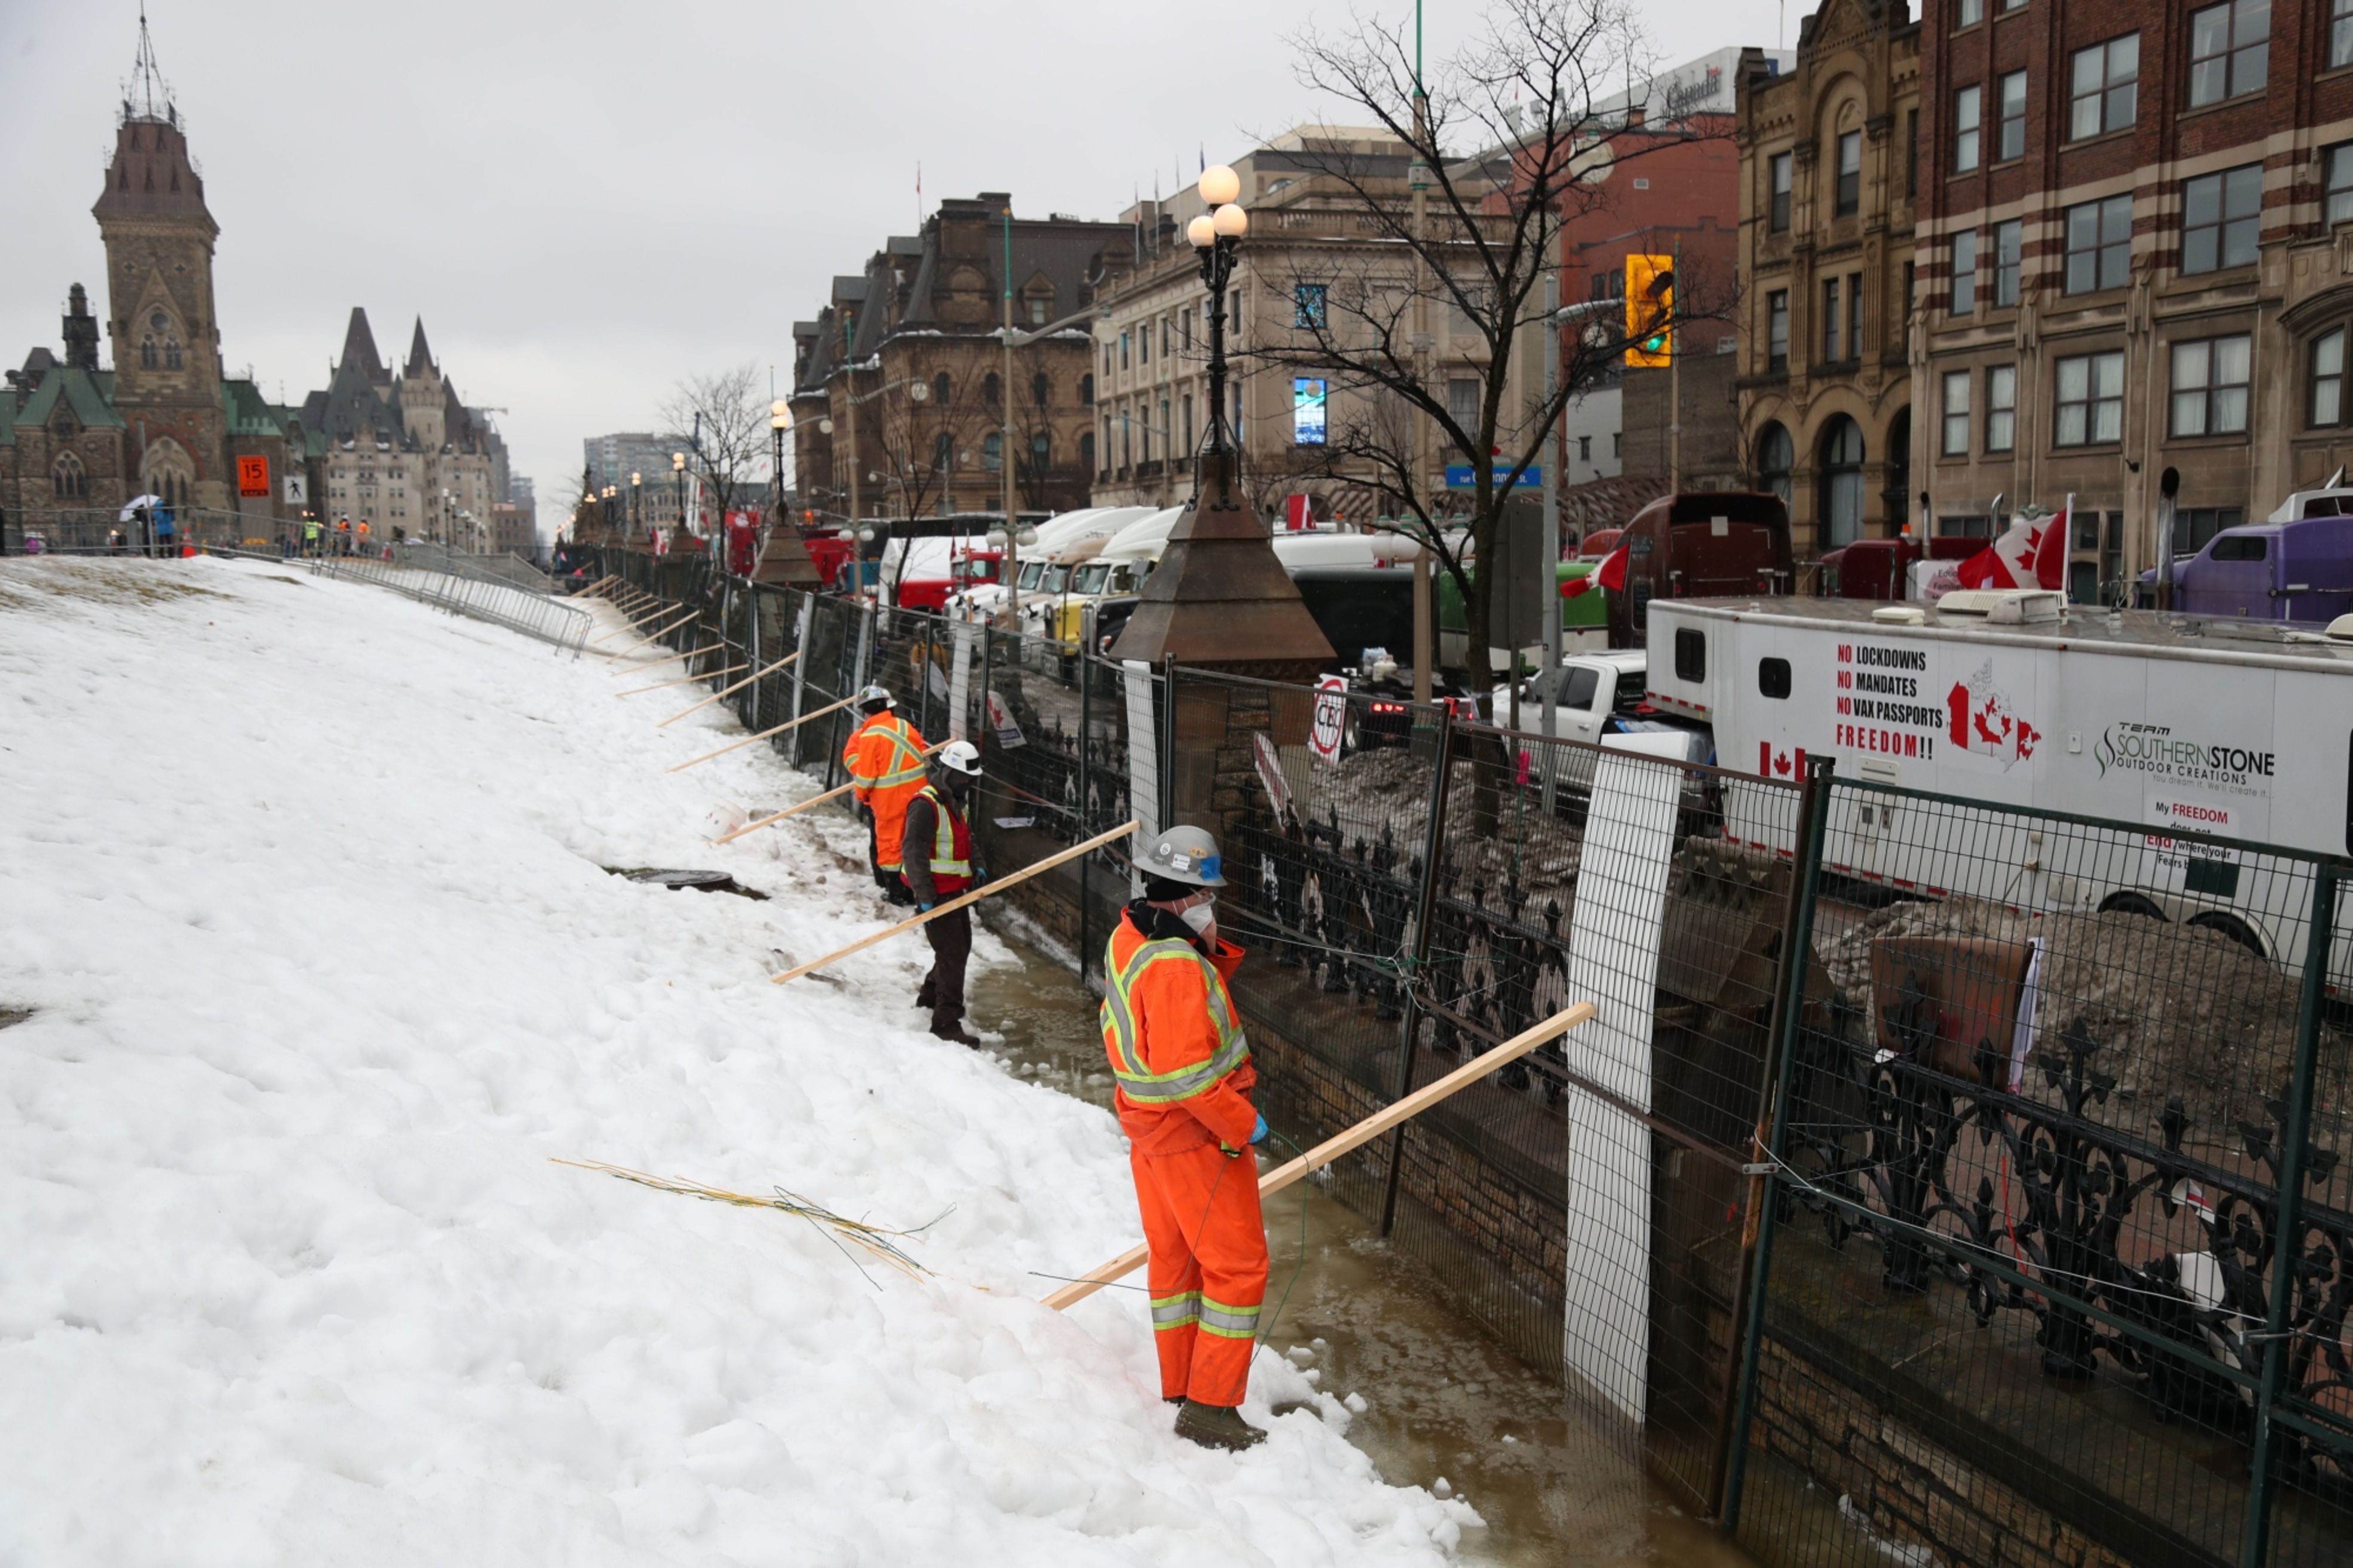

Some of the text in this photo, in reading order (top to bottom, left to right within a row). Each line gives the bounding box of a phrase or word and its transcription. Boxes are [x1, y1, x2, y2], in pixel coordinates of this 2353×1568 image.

[245, 464, 263, 479] 15
[1837, 644, 1926, 671] NO LOCKDOWNS
[1837, 670, 1917, 698] NO MANDATES
[1837, 696, 1943, 729] NO VAX PASSPORTS
[2119, 722, 2171, 736] TEAM
[1837, 724, 1932, 760] FREEDOM!!
[2116, 757, 2247, 786] OUTDOOR CREATIONS
[2152, 774, 2166, 784] You
[2169, 776, 2194, 787] dream
[2229, 786, 2258, 797] create
[2156, 802, 2228, 825] My FREEDOM
[2158, 854, 2182, 868] Fears
[2178, 841, 2231, 858] where your
